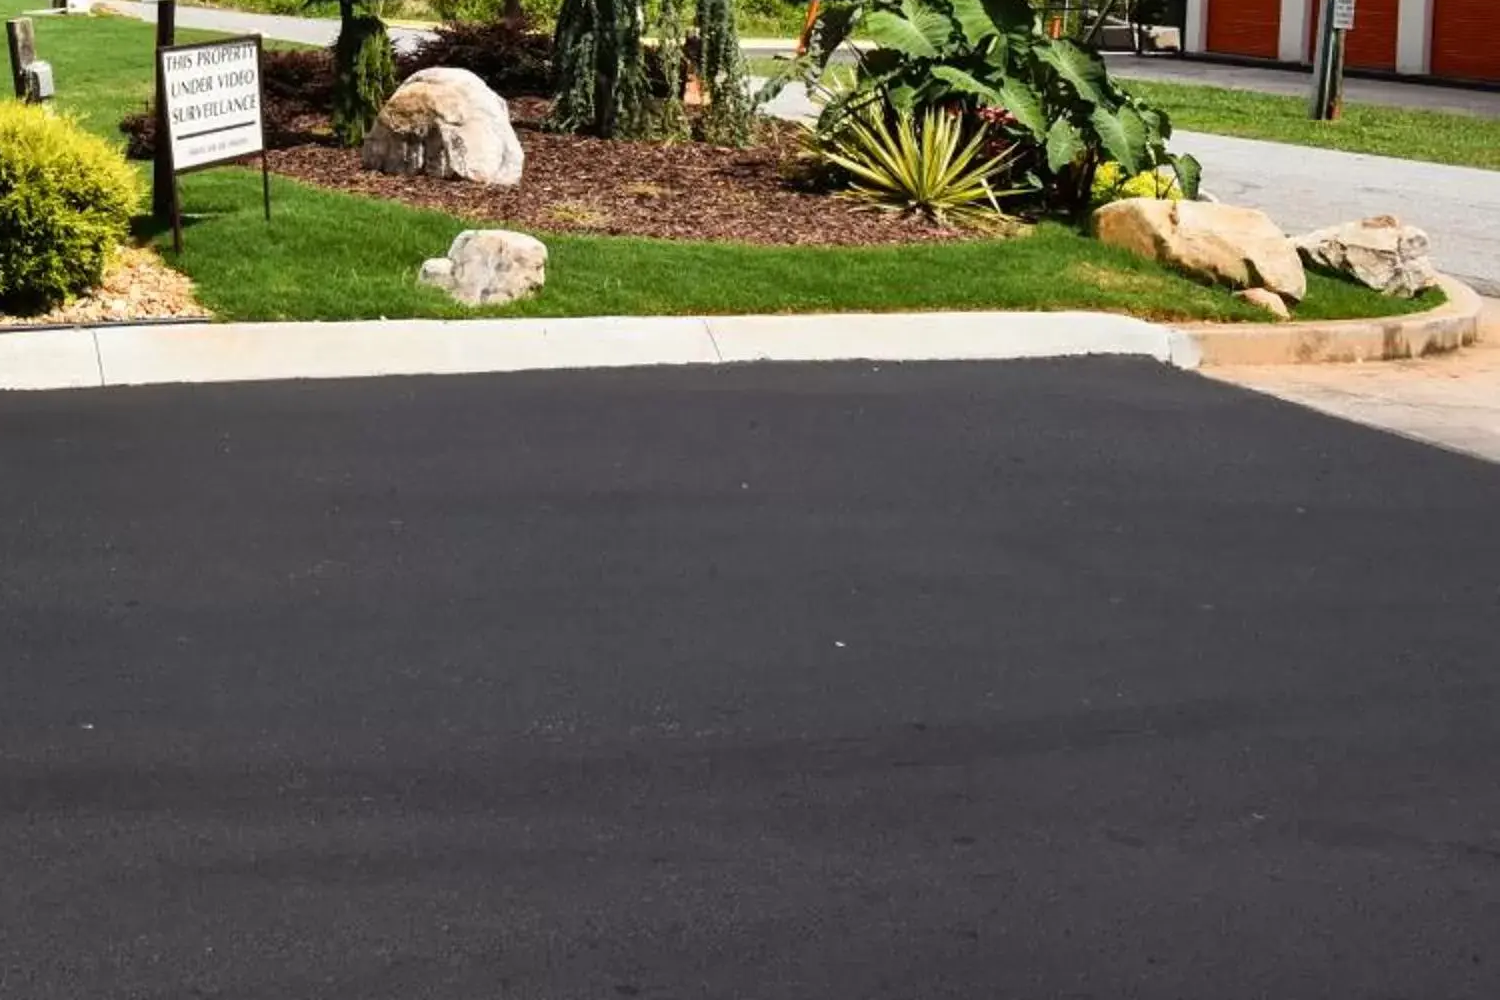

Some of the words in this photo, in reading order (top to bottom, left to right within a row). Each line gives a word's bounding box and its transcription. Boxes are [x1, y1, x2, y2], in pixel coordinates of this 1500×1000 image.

[166, 55, 193, 72] THIS
[197, 43, 254, 66] PROPERTY
[171, 76, 212, 97] UNDER
[217, 70, 255, 89] VIDEO
[172, 94, 257, 125] SURVEILLANCE
